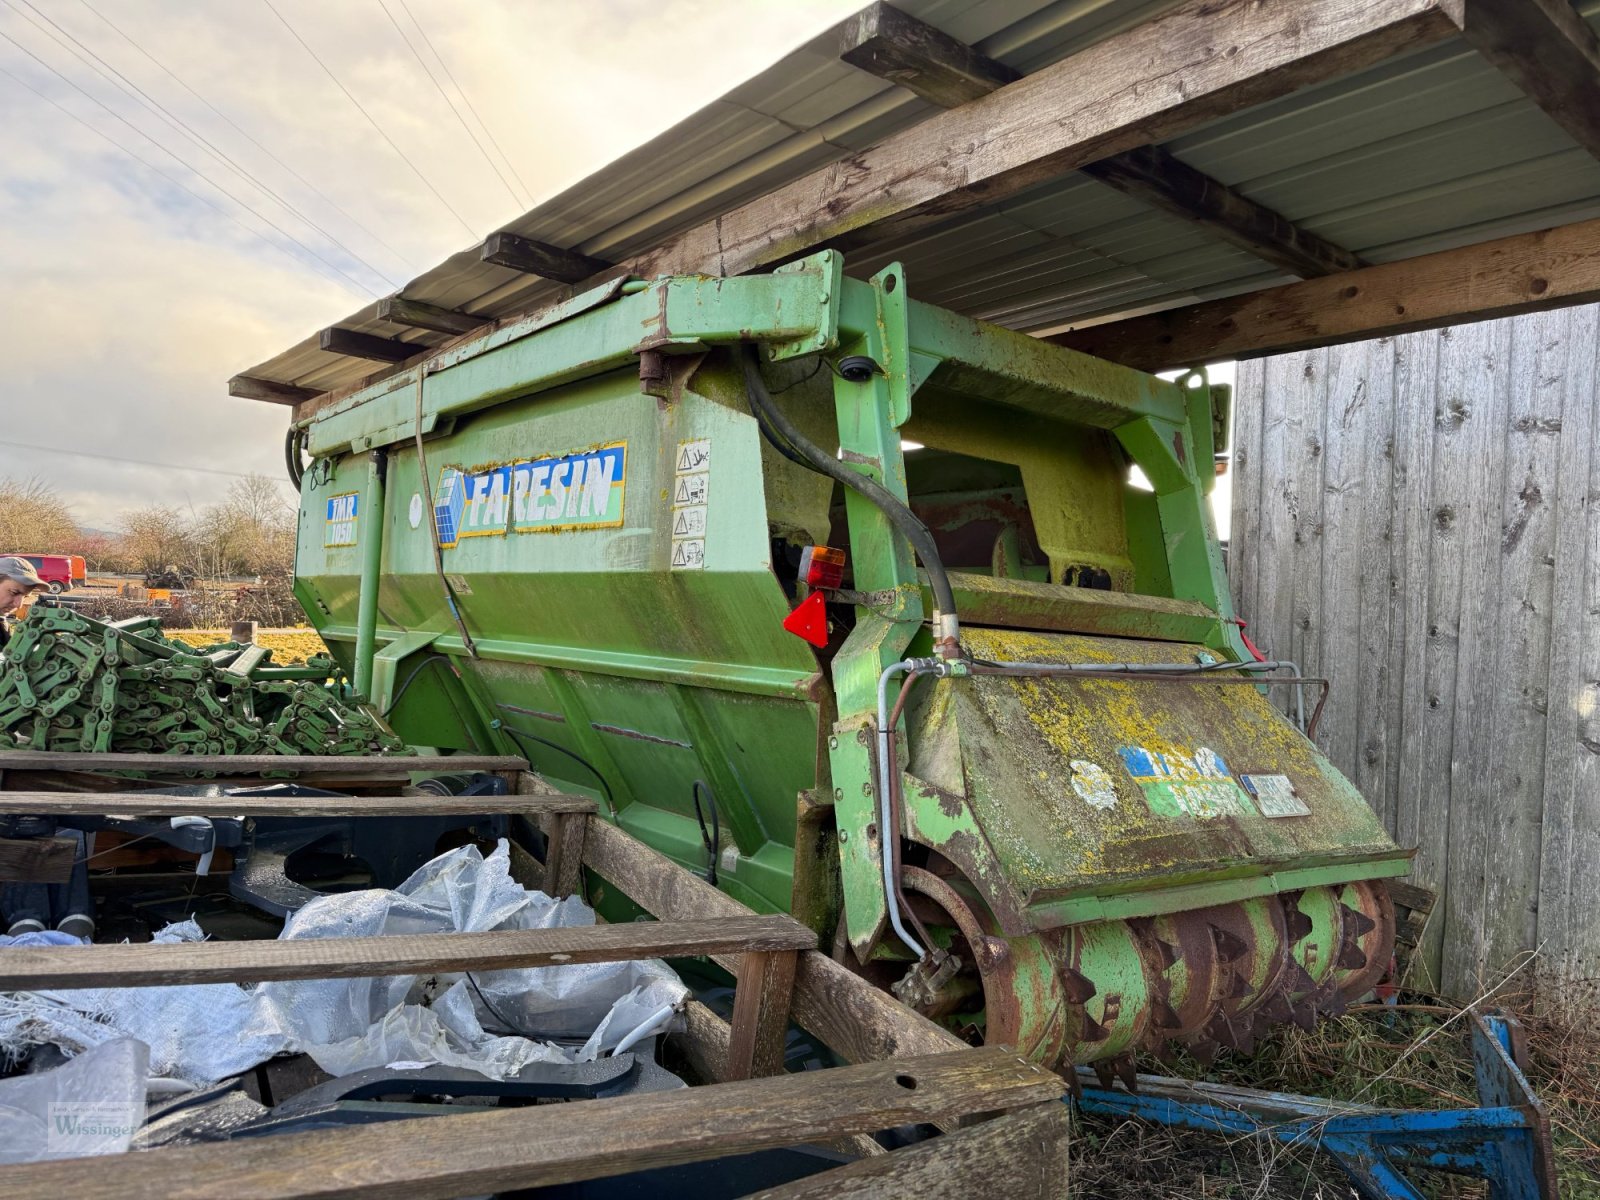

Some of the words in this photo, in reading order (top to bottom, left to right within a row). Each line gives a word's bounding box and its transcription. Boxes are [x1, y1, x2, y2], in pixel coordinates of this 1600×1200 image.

[469, 455, 615, 526] FARESIN
[331, 496, 355, 522] TMR
[331, 523, 353, 544] 1050
